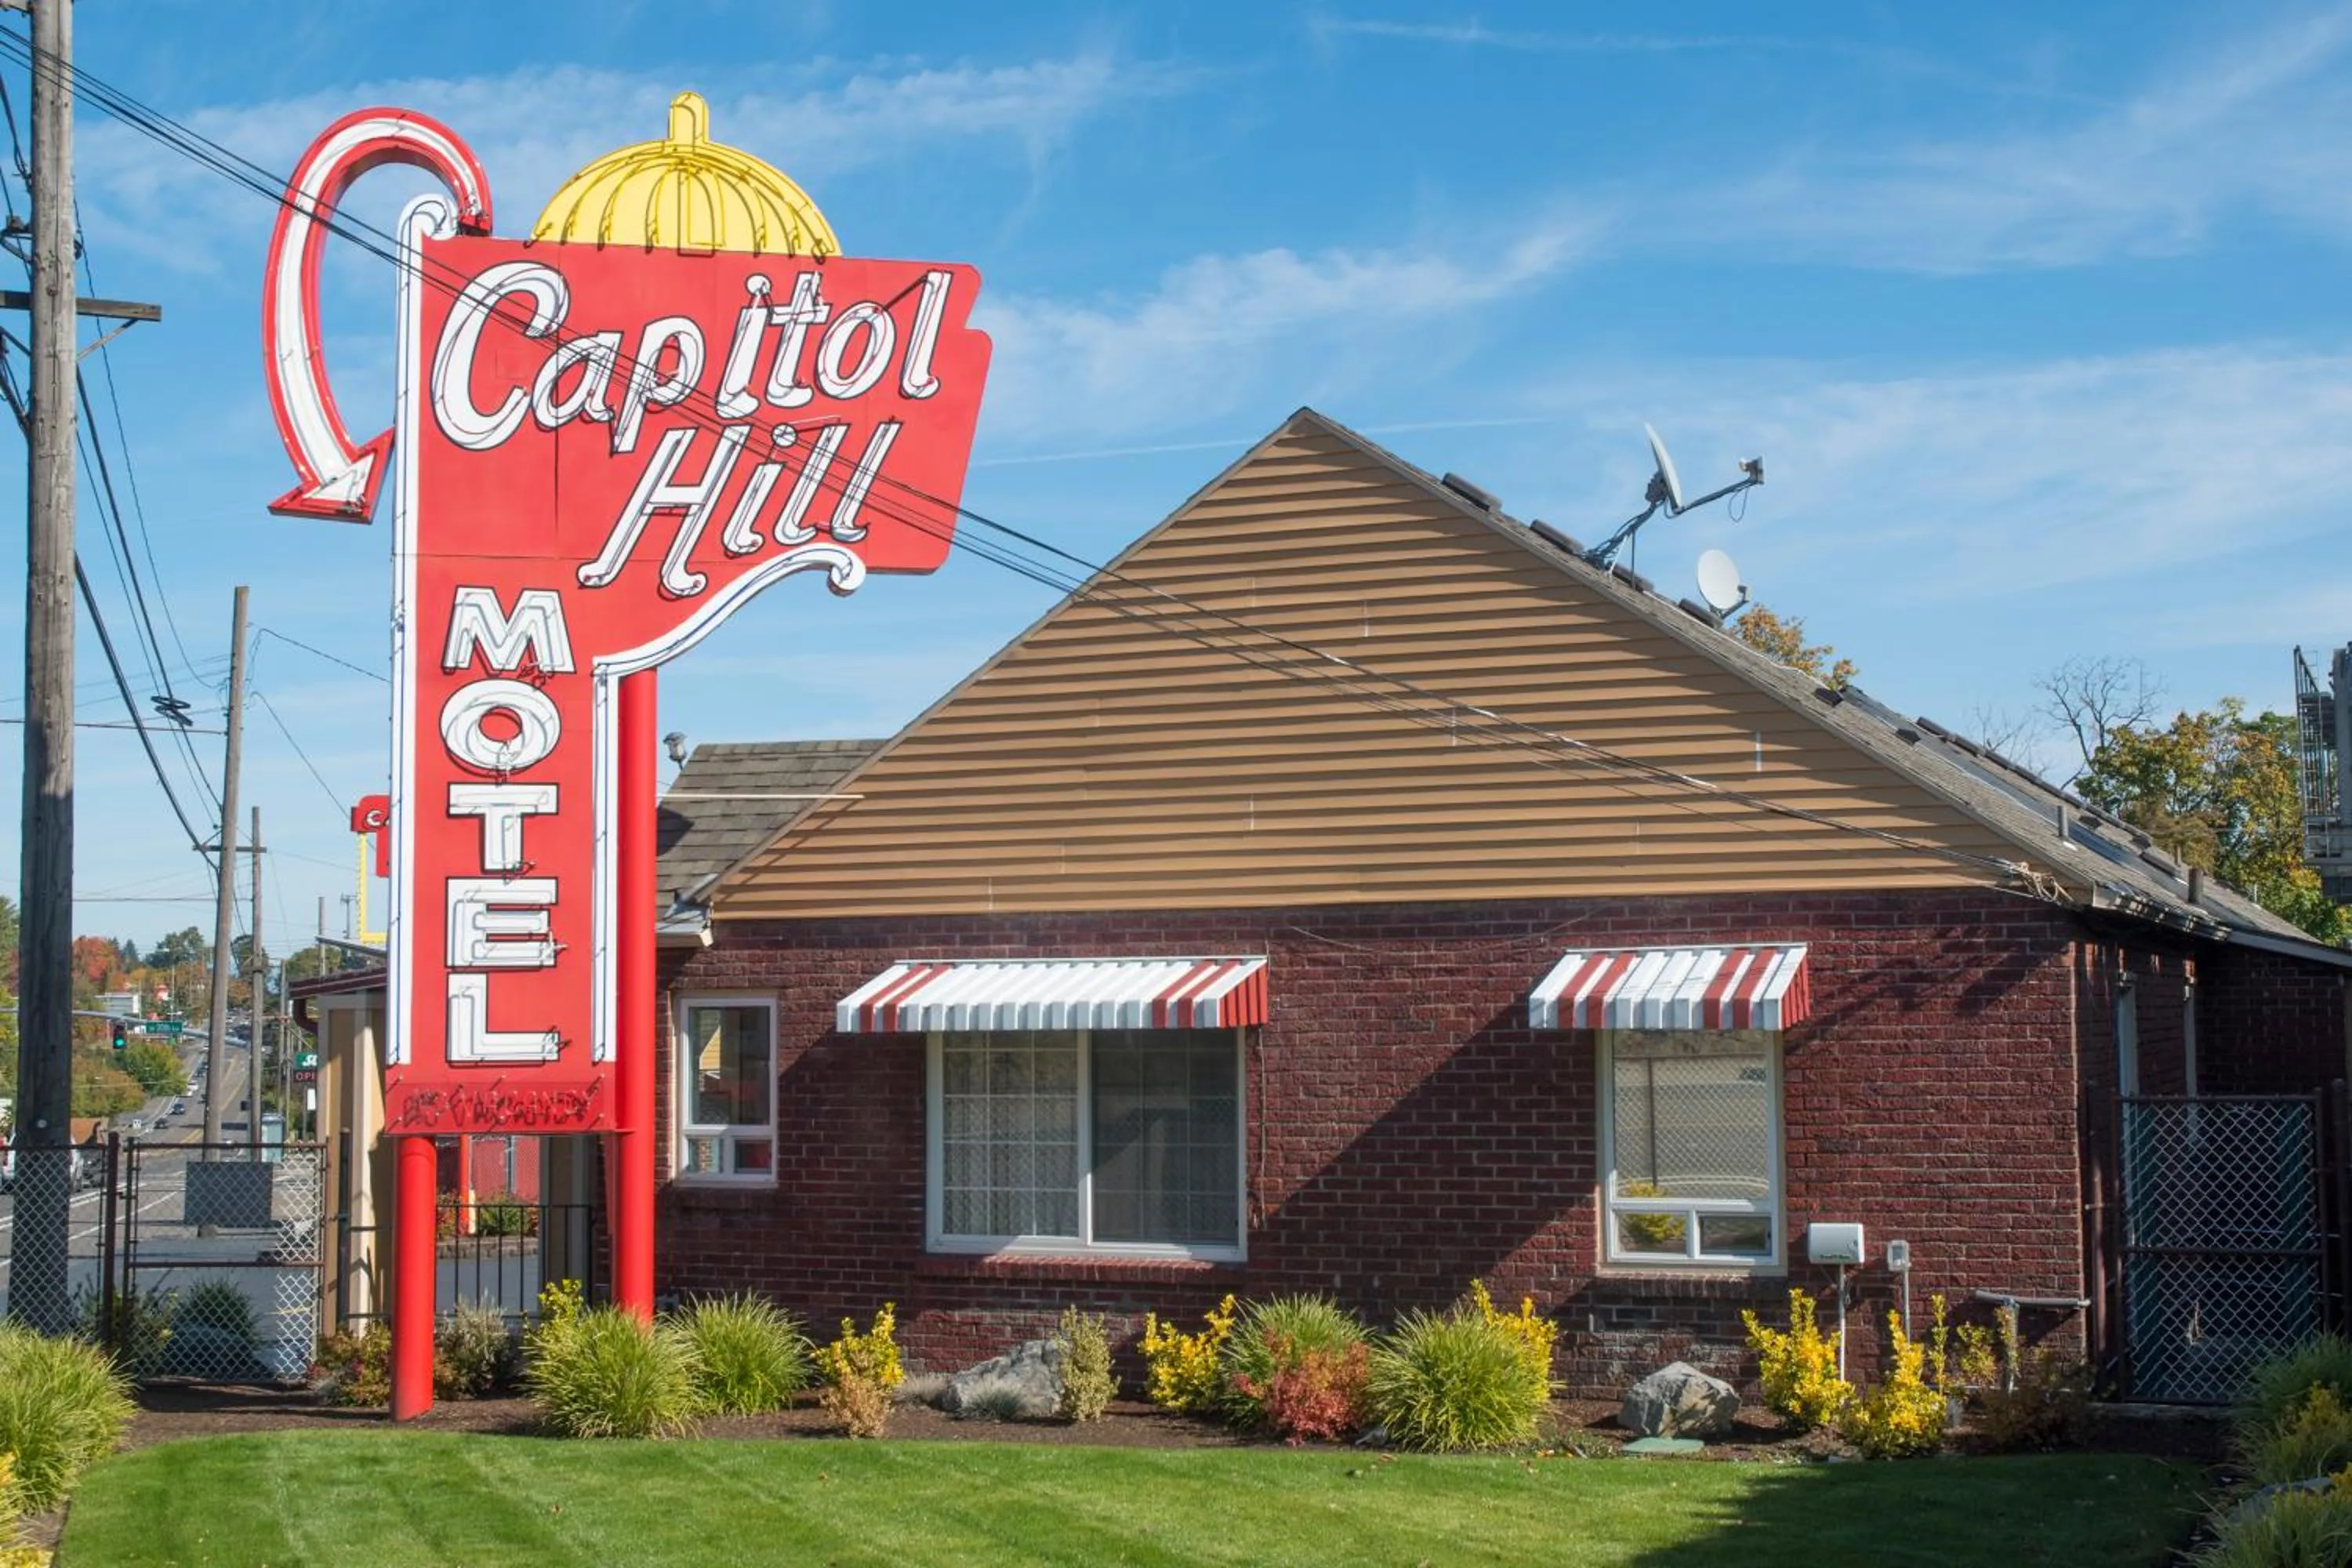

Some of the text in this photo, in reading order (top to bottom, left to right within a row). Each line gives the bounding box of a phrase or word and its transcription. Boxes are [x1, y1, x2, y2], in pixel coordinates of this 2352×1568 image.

[430, 260, 953, 454] Capitol
[575, 420, 903, 597] Hill
[439, 586, 577, 1063] MOTEL
